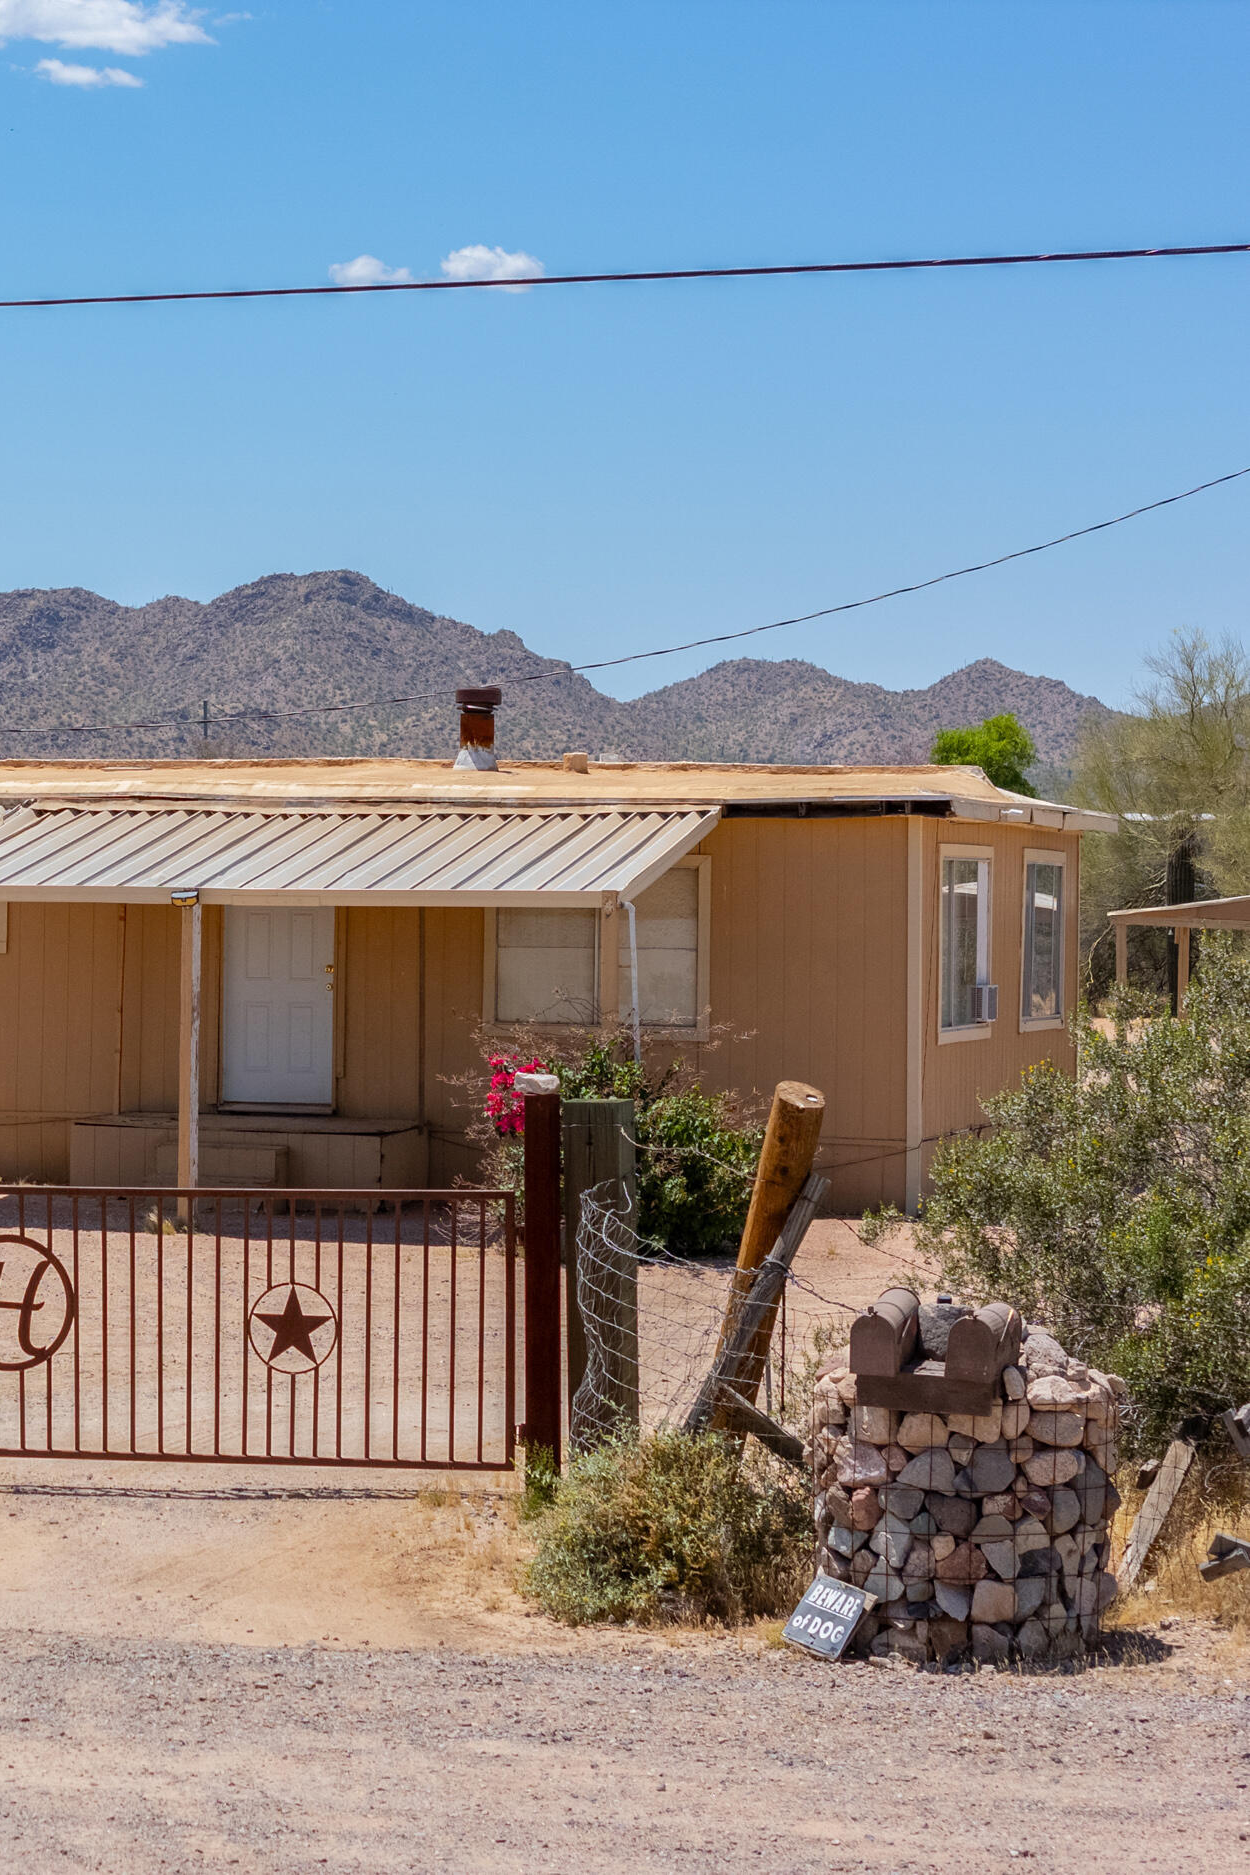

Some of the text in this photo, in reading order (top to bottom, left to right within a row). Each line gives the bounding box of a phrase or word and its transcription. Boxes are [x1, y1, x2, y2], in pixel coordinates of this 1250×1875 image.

[809, 1584, 861, 1618] BEWARE
[792, 1614, 845, 1643] of DOG
